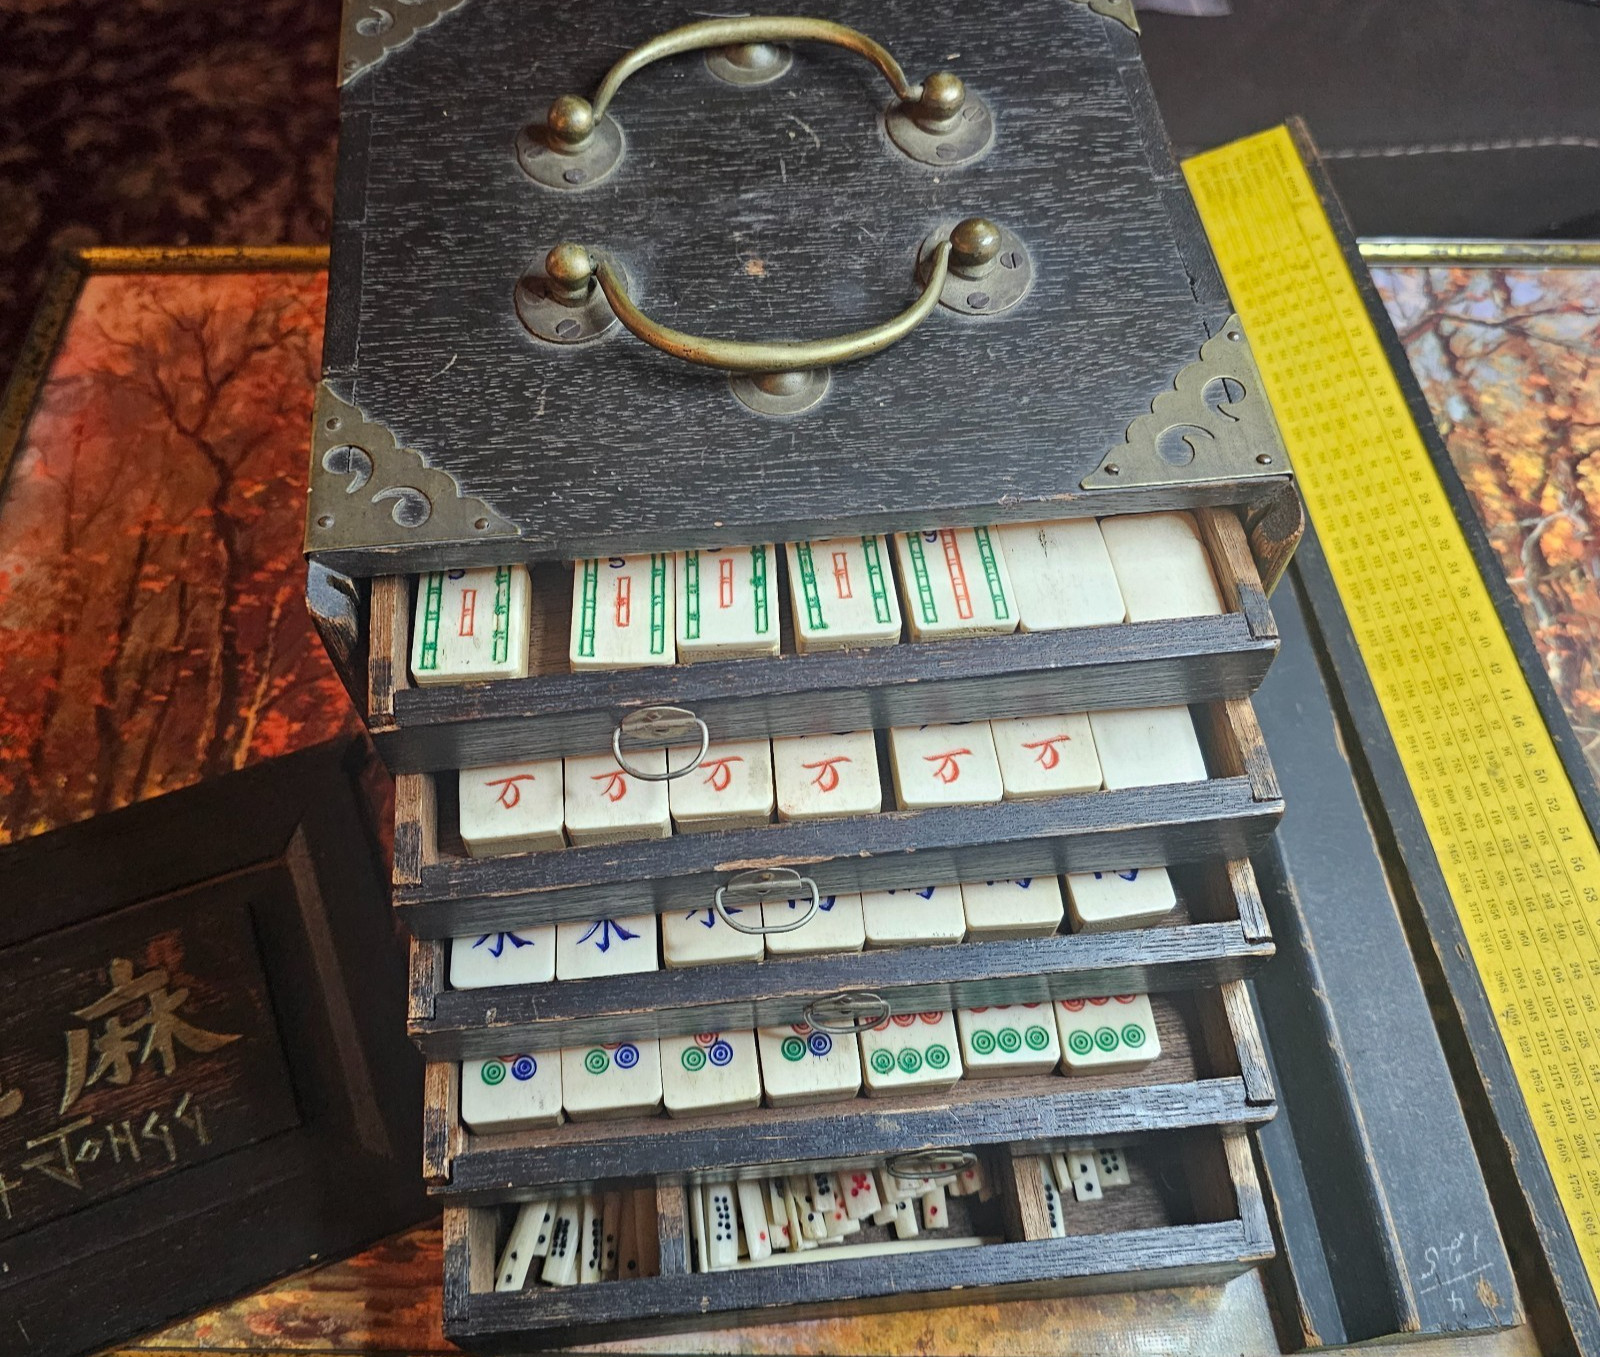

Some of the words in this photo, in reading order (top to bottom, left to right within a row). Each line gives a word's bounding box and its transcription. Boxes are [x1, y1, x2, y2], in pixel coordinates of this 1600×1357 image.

[1382, 405, 1396, 417] 20
[1391, 427, 1404, 440] 22
[1400, 448, 1413, 460] 24
[1409, 470, 1422, 483] 26
[1418, 492, 1431, 505] 28
[1428, 514, 1441, 527] 30
[1437, 538, 1450, 551] 32
[1447, 561, 1460, 574] 34
[1457, 585, 1470, 598] 36
[1467, 609, 1481, 623] 38
[1478, 635, 1491, 648] 40
[1489, 661, 1502, 674] 42
[1500, 688, 1513, 700] 44
[1511, 714, 1524, 728] 46
[1522, 741, 1536, 756] 48
[1533, 768, 1548, 783] 50
[1545, 797, 1560, 812] 52
[1557, 826, 1573, 841] 54
[1570, 856, 1585, 872] 56
[1582, 887, 1597, 902] 58
[485, 773, 535, 809] 万
[591, 770, 628, 802] 万
[698, 755, 744, 792] 万
[801, 756, 852, 792] 万
[922, 747, 973, 784] 万
[1021, 734, 1071, 770] 万
[1467, 754, 1480, 769] 384
[1479, 781, 1491, 797] 400
[1489, 809, 1502, 825] 416
[1501, 837, 1514, 855] 432
[1512, 866, 1525, 883] 448
[1523, 896, 1537, 912] 464
[1535, 926, 1549, 943] 480
[1551, 966, 1565, 983] 496
[1563, 997, 1577, 1016] 512
[1575, 1030, 1590, 1049] 528
[1484, 750, 1498, 767] 192
[1494, 777, 1508, 793] 200
[1506, 804, 1519, 821] 208
[1517, 833, 1531, 850] 216
[1529, 862, 1544, 879] 224
[1541, 892, 1555, 909] 232
[1553, 922, 1567, 940] 240
[1569, 962, 1583, 980] 248
[1581, 994, 1596, 1012] 256
[1501, 745, 1512, 756] 96
[1512, 773, 1525, 789] 100
[1524, 801, 1537, 817] 104
[1535, 829, 1549, 846] 108
[1547, 858, 1562, 876] 112
[1559, 888, 1573, 905] 116
[1571, 919, 1586, 936] 120
[1415, 760, 1429, 781] 3072
[1425, 787, 1440, 808] 3200
[1436, 815, 1451, 836] 3328
[1447, 843, 1461, 864] 3456
[1457, 872, 1472, 893] 3584
[1468, 901, 1483, 924] 3712
[1479, 931, 1494, 954] 3840
[1493, 970, 1509, 993] 3968
[1505, 1002, 1521, 1026] 4096
[1517, 1035, 1532, 1058] 4224
[1528, 1067, 1545, 1093] 4352
[1541, 1101, 1557, 1127] 4480
[1554, 1136, 1571, 1163] 4608
[1567, 1172, 1584, 1199] 4736
[1580, 1209, 1596, 1236] 4864
[1432, 756, 1446, 776] 1536
[1442, 783, 1457, 804] 1600
[1453, 811, 1467, 832] 1664
[1464, 839, 1478, 860] 1728
[1474, 868, 1490, 890] 1792
[1485, 897, 1501, 920] 1856
[1497, 928, 1512, 950] 1920
[1511, 966, 1527, 989] 1984
[1523, 998, 1539, 1022] 2048
[1535, 1030, 1552, 1055] 2112
[1547, 1064, 1565, 1089] 2176
[1560, 1098, 1577, 1123] 2240
[1573, 1133, 1590, 1159] 2304
[1451, 757, 1463, 773] 768
[1462, 785, 1473, 800] 800
[1472, 812, 1485, 829] 832
[1483, 840, 1496, 857] 864
[1494, 870, 1507, 887] 896
[1505, 899, 1519, 916] 928
[1517, 929, 1530, 946] 960
[1531, 968, 1546, 986] 992
[1541, 995, 1558, 1018] 1024
[1554, 1027, 1571, 1052] 1056
[1566, 1061, 1584, 1086] 1088
[1579, 1095, 1595, 1120] 1120
[59, 958, 243, 1114] 麻
